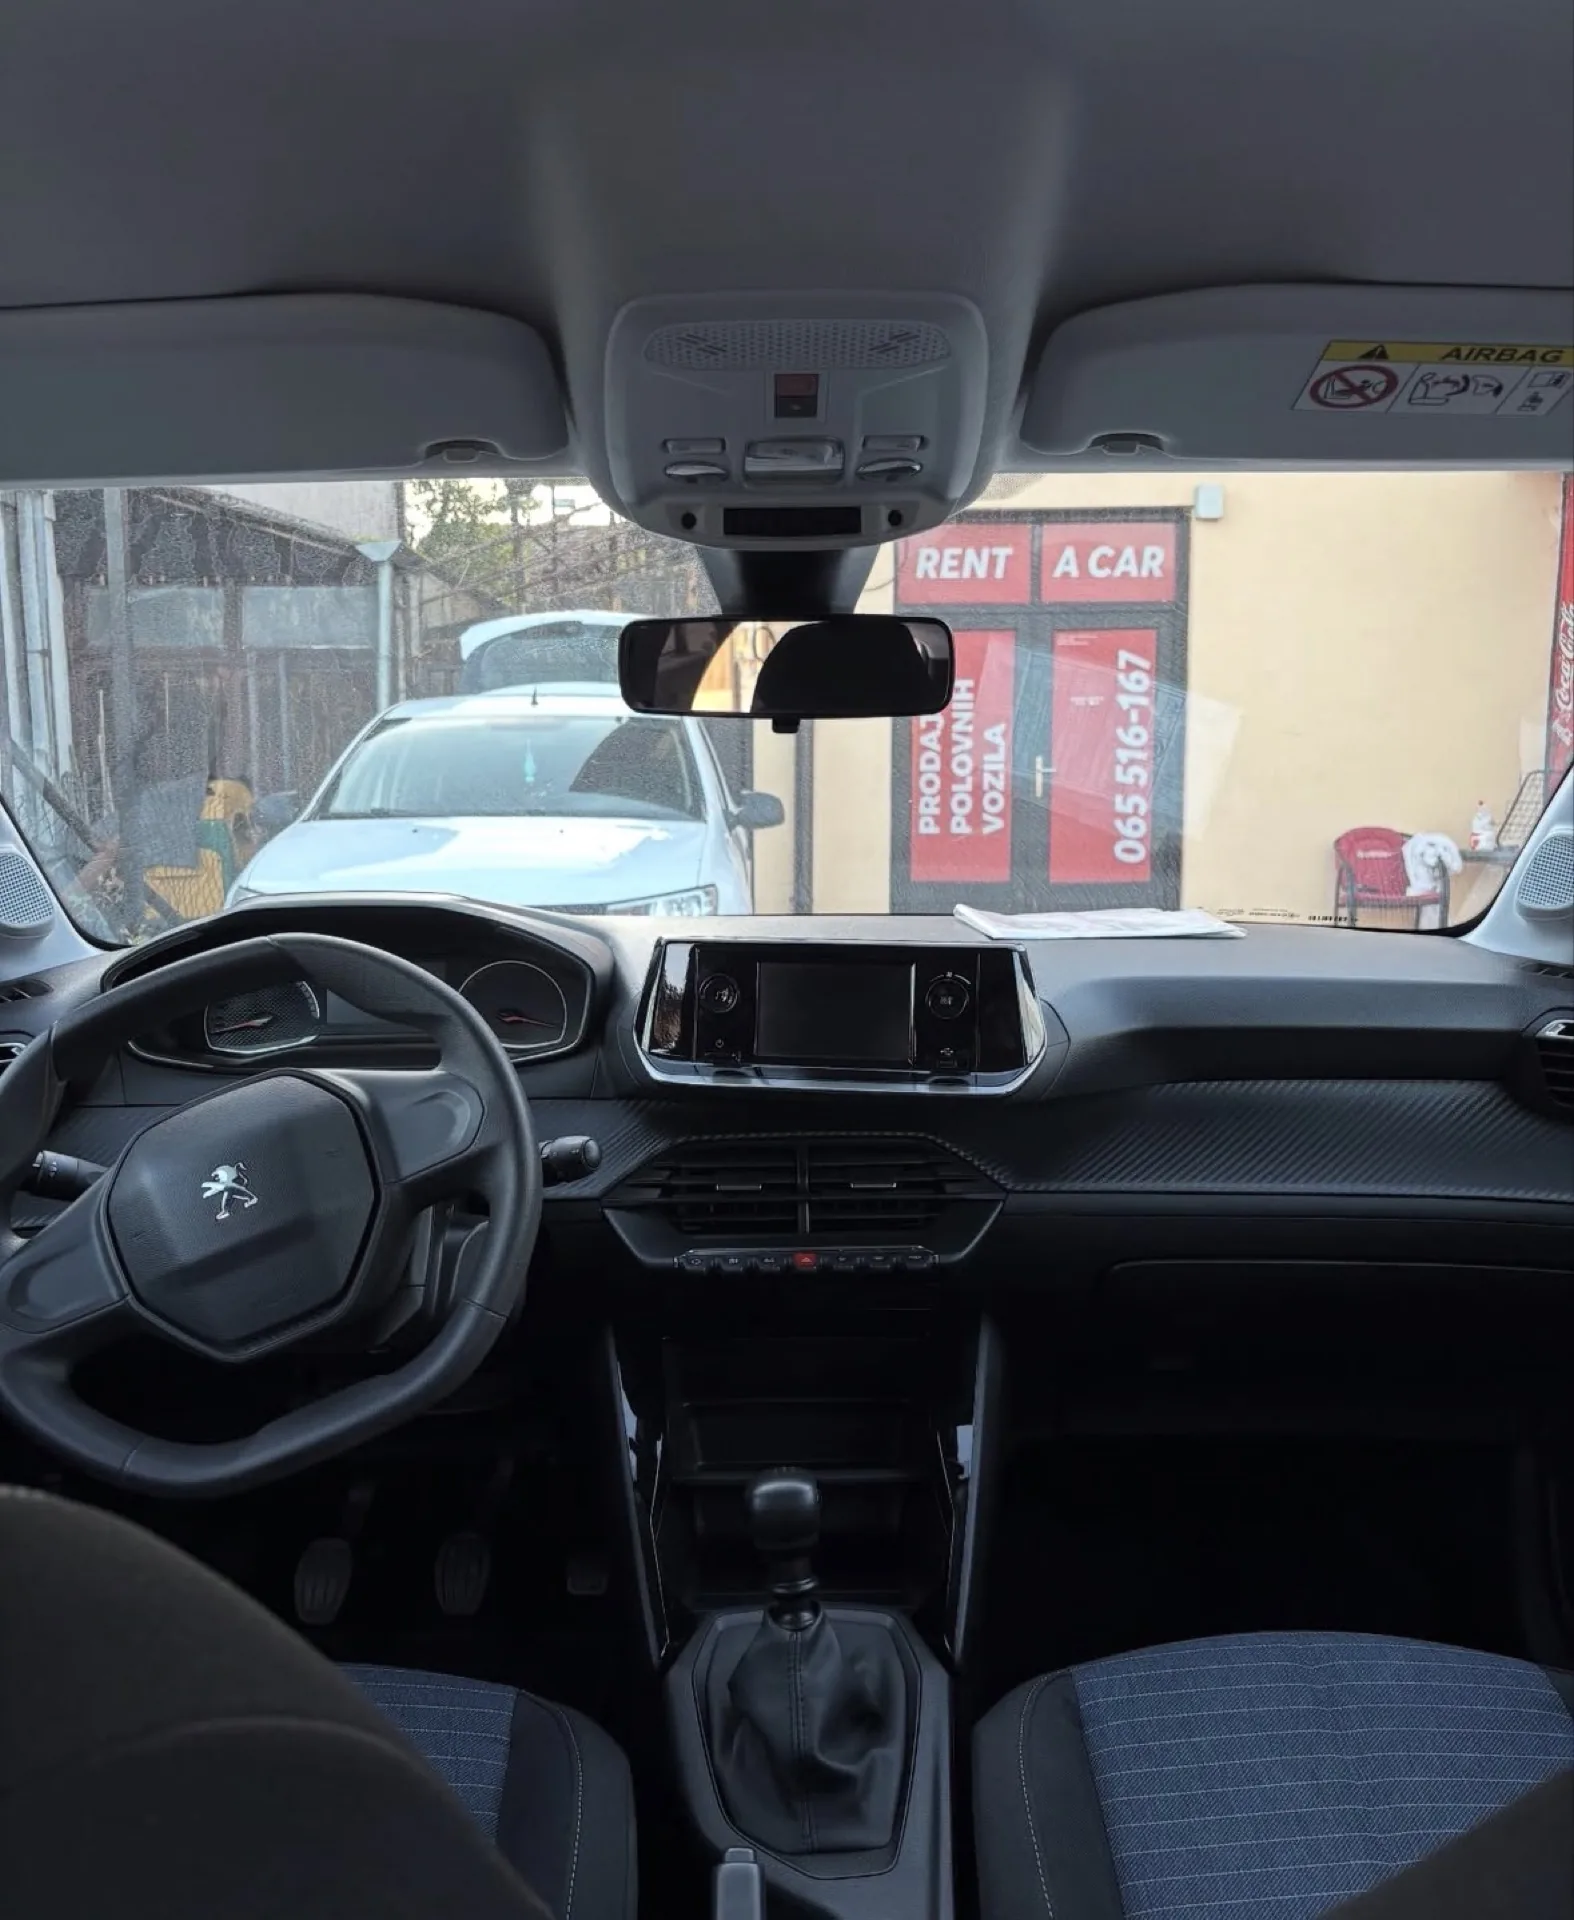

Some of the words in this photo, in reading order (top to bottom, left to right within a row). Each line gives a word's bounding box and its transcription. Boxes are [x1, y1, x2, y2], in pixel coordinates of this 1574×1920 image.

[1440, 346, 1565, 363] AIRBAG
[915, 545, 1014, 579] RENT
[1051, 545, 1080, 578] A
[1087, 545, 1165, 578] CAR
[918, 714, 945, 834] PRODAJ
[950, 679, 975, 834] POLOVNIH
[1115, 649, 1151, 787] 516-167
[982, 722, 1006, 834] VOZILA
[1113, 793, 1148, 864] 065
